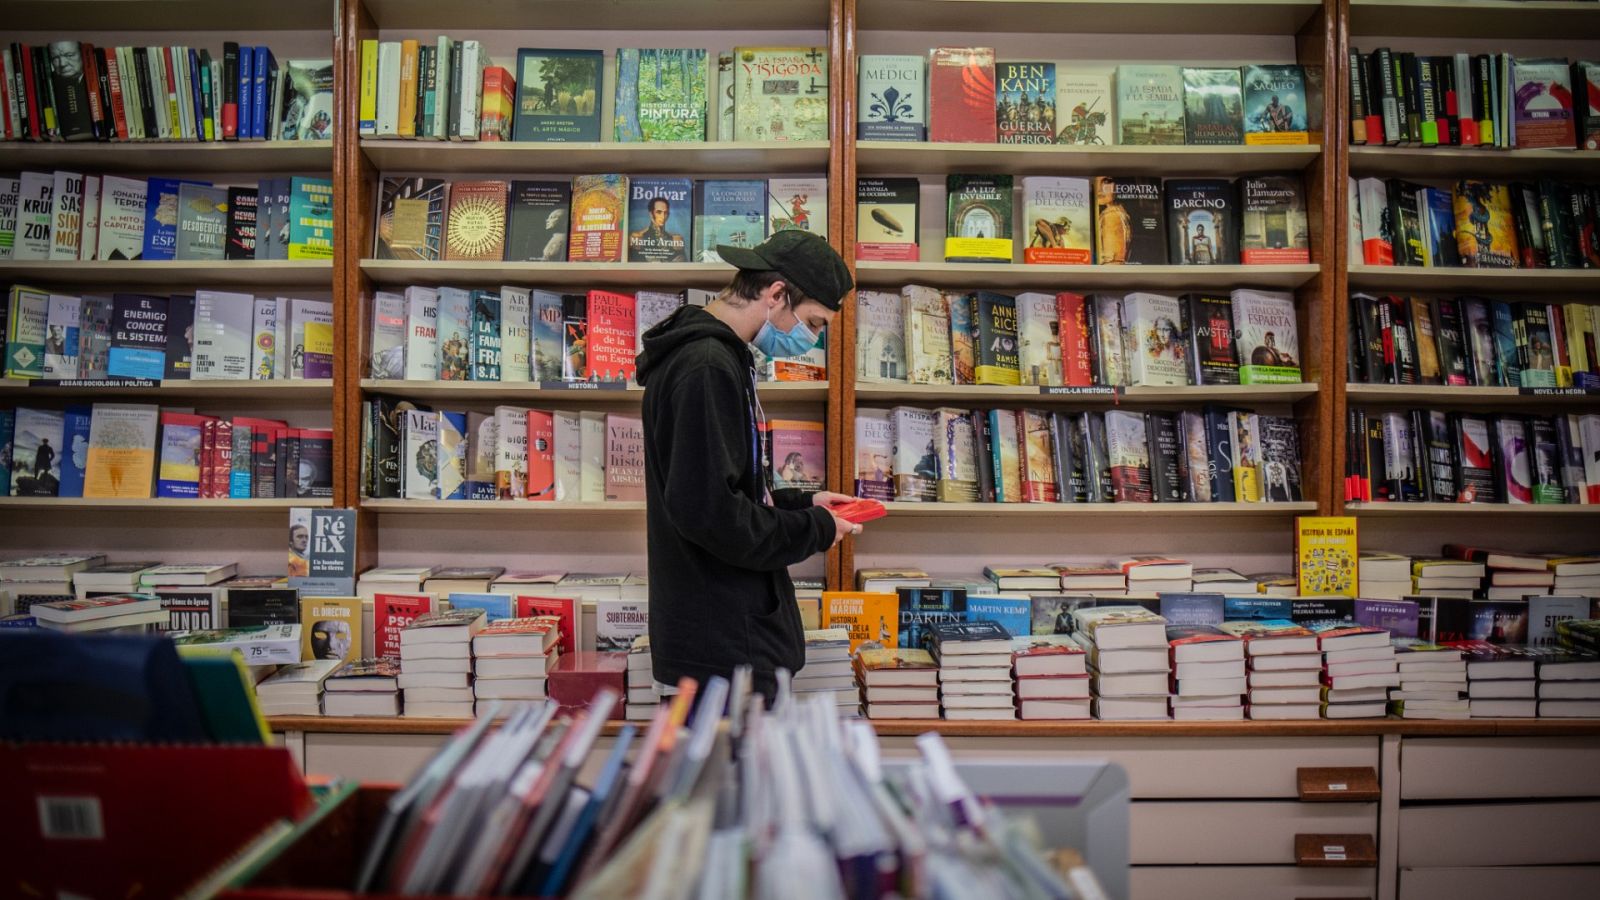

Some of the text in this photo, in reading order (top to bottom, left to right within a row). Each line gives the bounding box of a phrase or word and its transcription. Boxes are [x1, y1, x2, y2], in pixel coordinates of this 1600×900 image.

[774, 54, 805, 64] ESPAÑA
[742, 63, 822, 77] VISIGODA
[866, 69, 918, 81] MEDICI
[1008, 65, 1044, 79] BEN
[1421, 62, 1432, 82] JAMES
[1000, 78, 1050, 92] KANE
[1254, 82, 1295, 92] SAQUEO
[1142, 86, 1172, 95] ESPADA
[1145, 94, 1179, 102] SEMILLA
[640, 108, 699, 119] PINTURA
[1000, 120, 1051, 132] GUERRA
[1000, 134, 1051, 145] IMPERIOS
[1102, 183, 1159, 194] CLEOPATRA
[1246, 180, 1267, 189] Julio
[632, 186, 687, 201] Bolívar
[979, 186, 996, 194] LUZ
[1035, 190, 1084, 199] EL TRONO
[1193, 191, 1205, 199] EN
[1247, 188, 1296, 197] Llamazares
[960, 193, 1002, 201] INVISIBLE
[1035, 198, 1084, 208] DEL CÉSAR
[1173, 198, 1226, 209] BARCINO
[119, 216, 140, 224] MITO
[199, 233, 216, 245] CIVIL
[630, 237, 656, 247] Marie
[656, 237, 685, 247] Arana
[140, 300, 152, 309] EL
[593, 294, 622, 307] PAUL
[124, 309, 167, 321] ENEMIGO
[601, 316, 611, 325] La
[1248, 313, 1292, 328] ESPARTA
[126, 321, 165, 332] CONOCE
[479, 321, 491, 333] LA
[117, 331, 168, 344] EL SISTEMA
[617, 337, 625, 345] la
[125, 379, 154, 387] POLÍTICA
[865, 422, 876, 430] EL
[865, 430, 882, 438] DEL
[611, 440, 625, 452] la
[315, 515, 346, 535] Fé
[1326, 528, 1334, 536] DE
[1335, 527, 1355, 536] ESPAÑA
[312, 607, 351, 617] EL DIRECTOR
[830, 605, 864, 615] MARINA
[969, 604, 1028, 615] MARTIN KEMP
[830, 616, 858, 624] HISTORIA
[901, 611, 961, 624] DARIEN
[854, 624, 863, 632] DE
[388, 634, 400, 642] DE
[250, 646, 262, 656] 75
